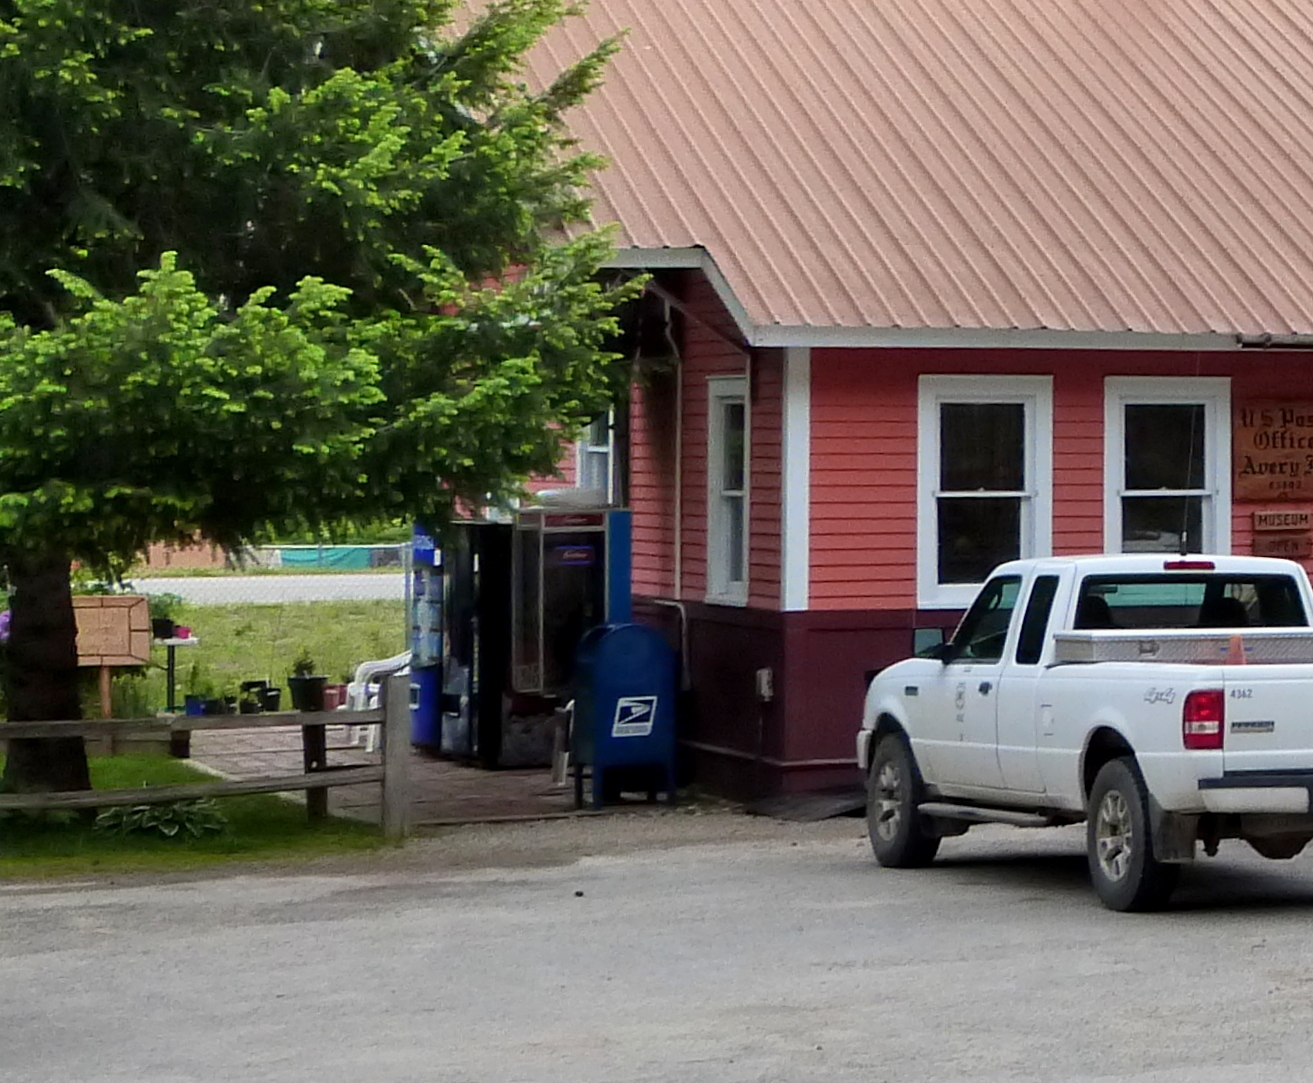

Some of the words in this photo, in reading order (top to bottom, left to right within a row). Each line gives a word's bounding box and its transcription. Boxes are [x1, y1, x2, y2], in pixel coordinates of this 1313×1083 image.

[1260, 408, 1274, 428] S
[1238, 455, 1301, 478] Avery
[1258, 513, 1309, 526] MUSEUM
[1267, 538, 1300, 554] OPEN
